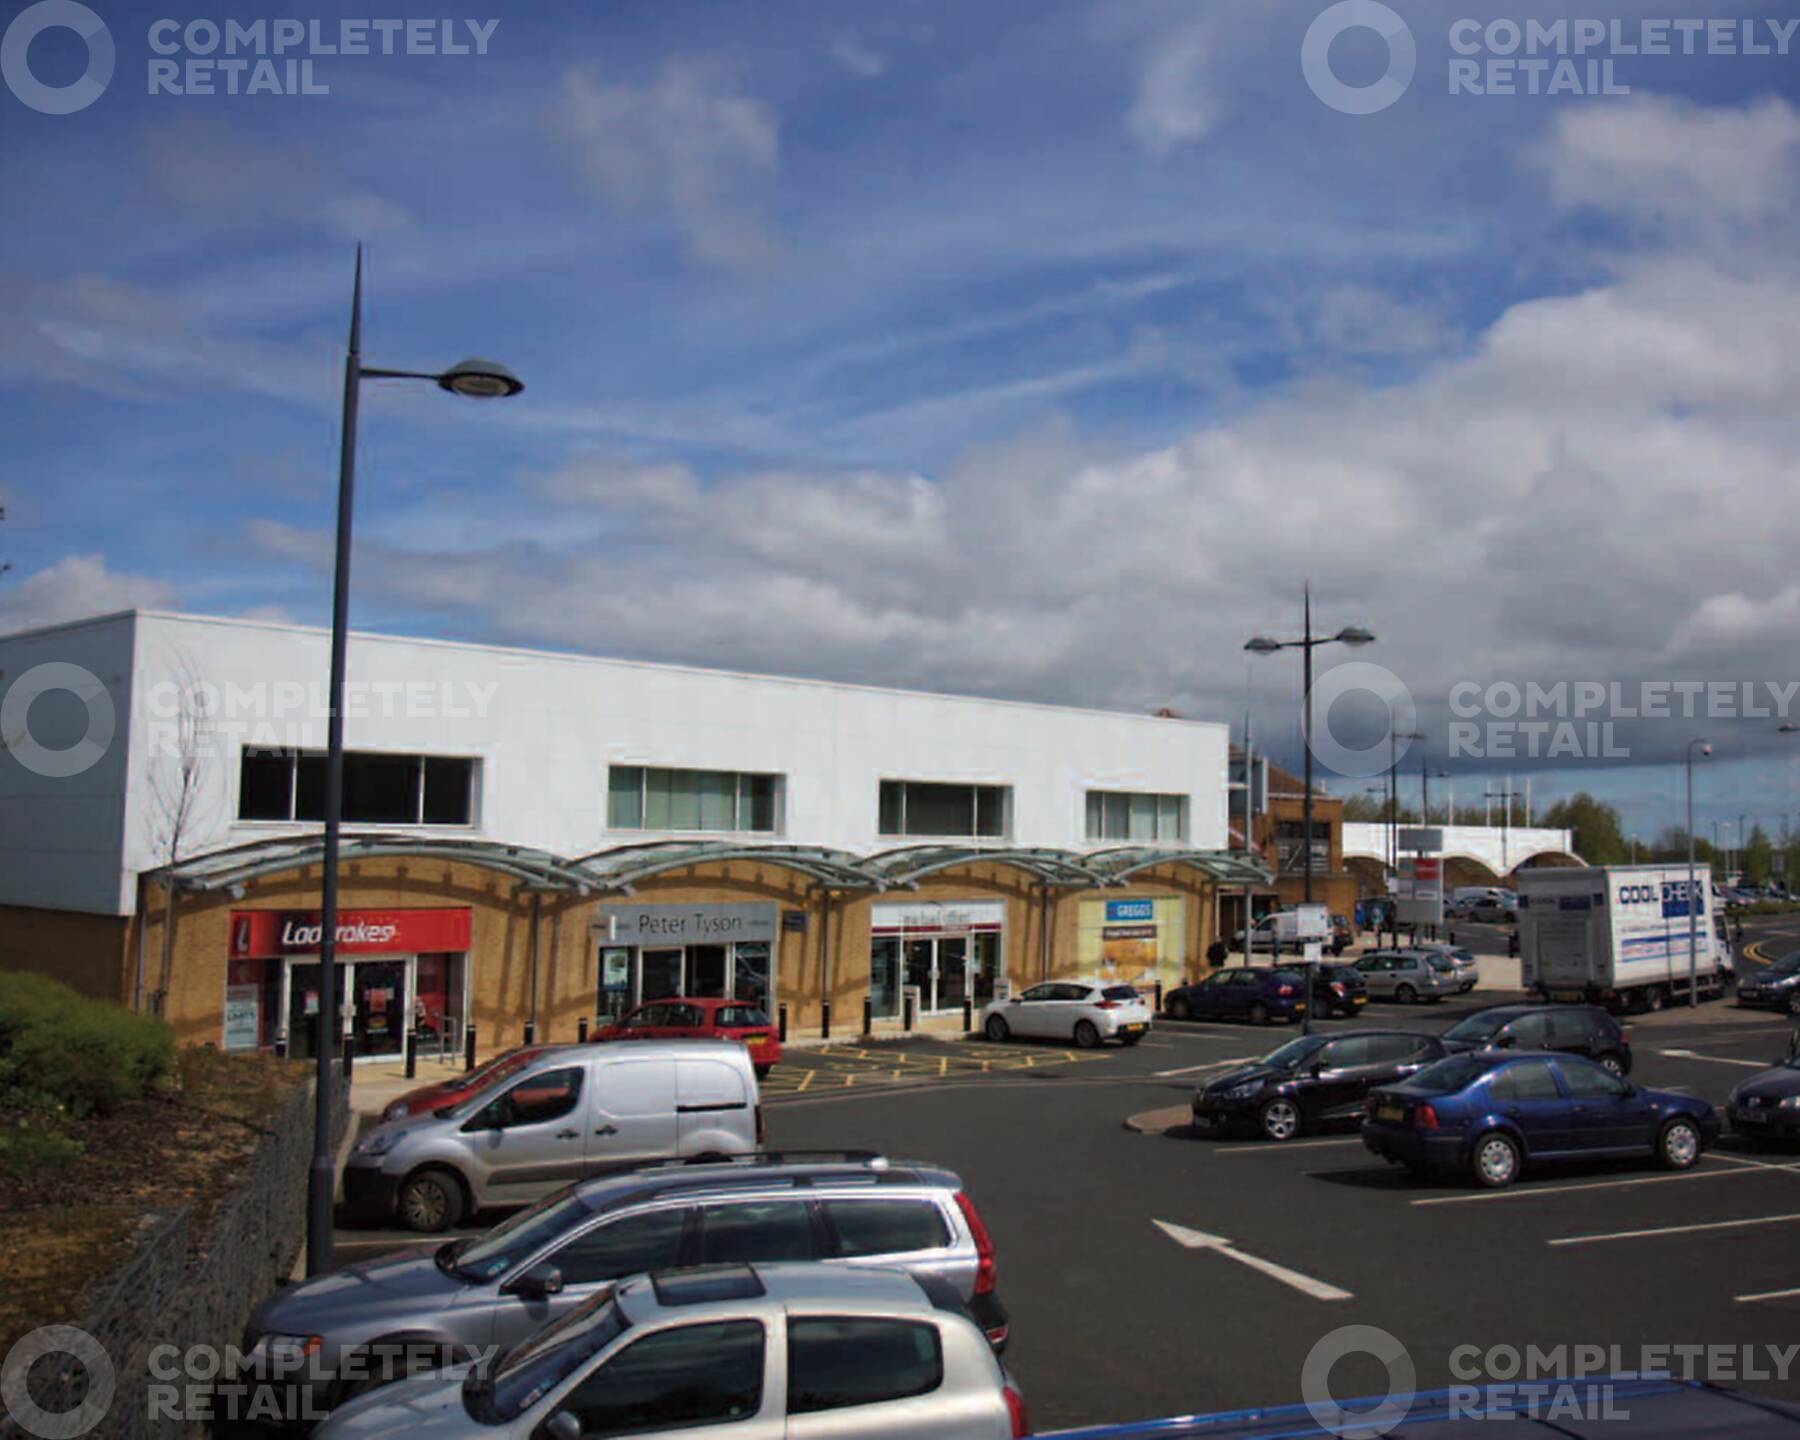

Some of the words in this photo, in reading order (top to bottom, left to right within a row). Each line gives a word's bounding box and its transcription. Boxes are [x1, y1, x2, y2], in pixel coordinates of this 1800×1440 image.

[1619, 885, 1659, 904] COOL
[282, 921, 395, 945] Ladrokes
[638, 913, 686, 934] Peter
[693, 912, 742, 934] Tyson
